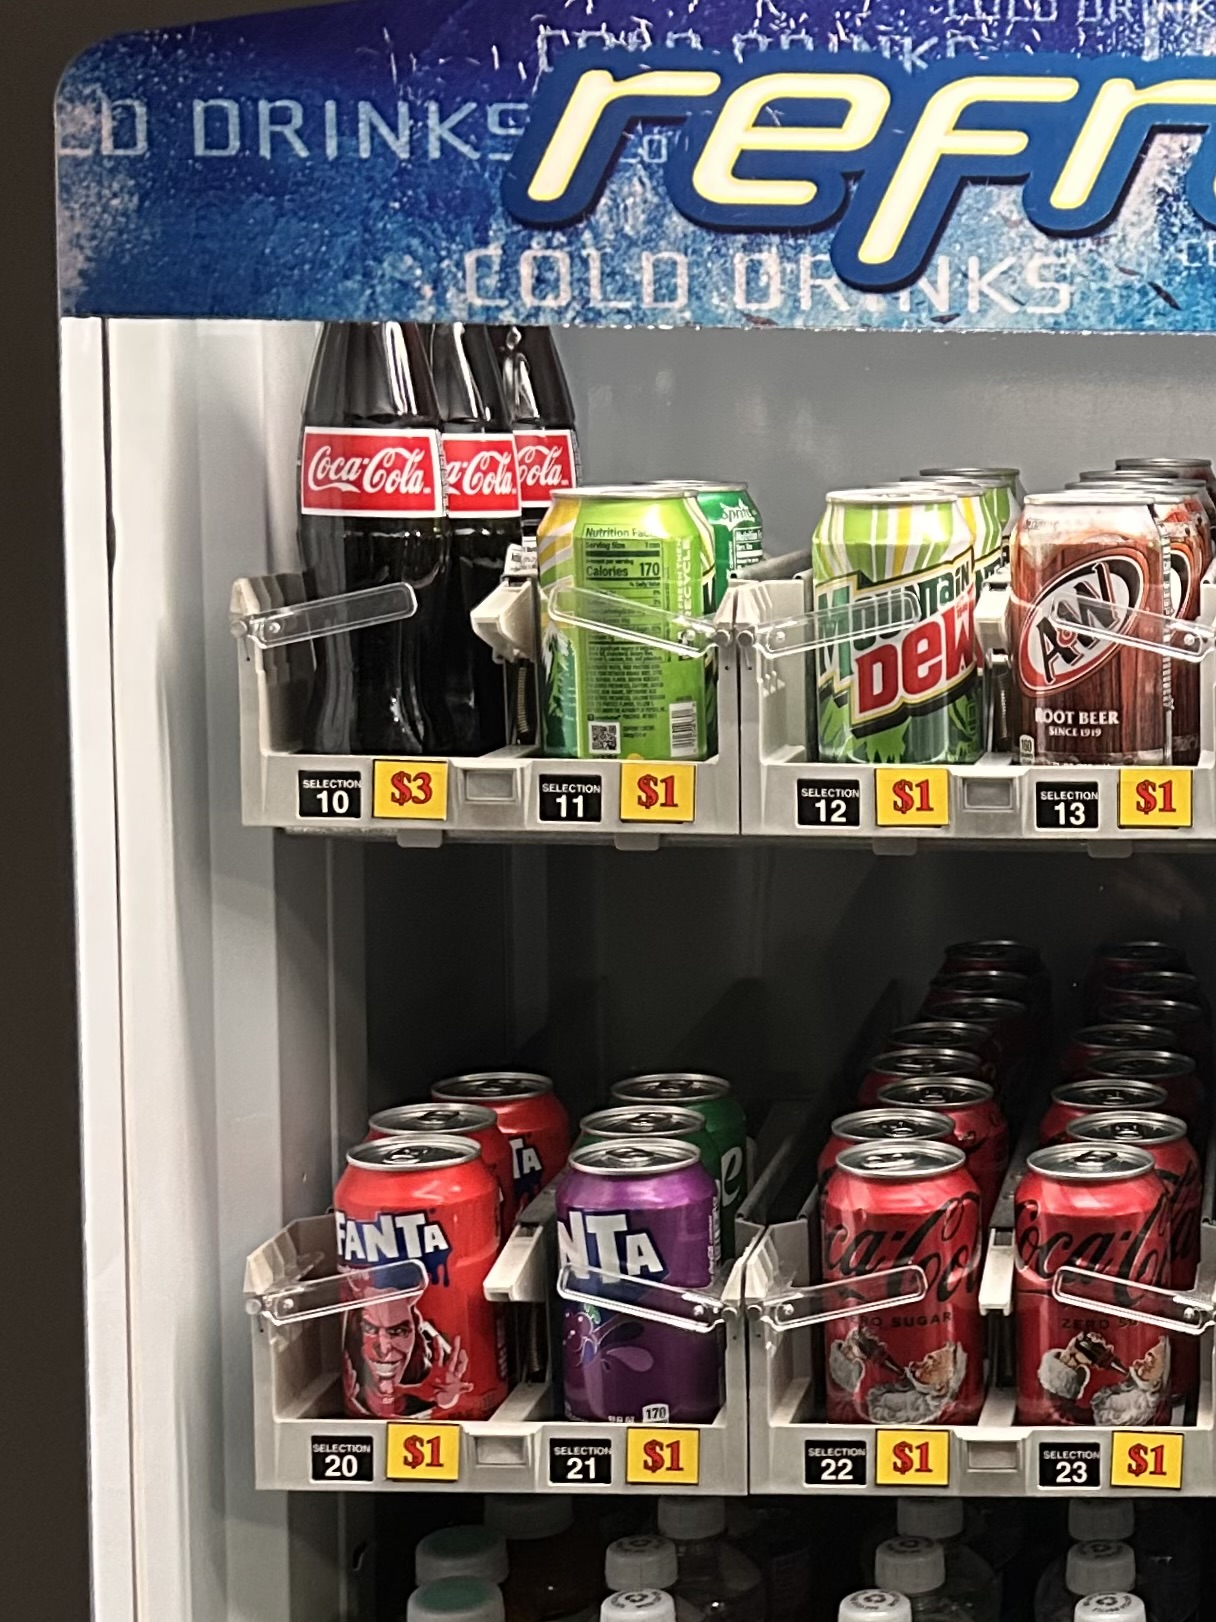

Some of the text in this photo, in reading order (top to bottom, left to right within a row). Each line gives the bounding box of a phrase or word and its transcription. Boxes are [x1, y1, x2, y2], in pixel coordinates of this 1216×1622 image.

[193, 98, 531, 161] DRINKS
[464, 246, 689, 310] COLD
[307, 444, 426, 495] Coca-Cola
[585, 527, 630, 538] Nutrition
[585, 565, 629, 578] Calories
[638, 561, 661, 577] 170
[1035, 561, 1120, 685] A&W
[1034, 709, 1121, 726] ROOT BEER
[1049, 726, 1102, 738] SINCE 1919
[302, 778, 360, 788] SELECTION
[391, 771, 432, 806] $3
[541, 783, 601, 793] SELECTION
[636, 774, 678, 810] $1
[800, 787, 859, 797] SELECTION
[1039, 790, 1098, 800] SELECTION
[316, 790, 349, 814] 10
[555, 794, 584, 818] 11
[891, 779, 934, 815] $1
[1134, 780, 1176, 816] $1
[814, 799, 847, 823] 12
[1054, 801, 1086, 826] 13
[336, 1210, 449, 1263] FANTA
[890, 1311, 953, 1328] SUGAR
[1060, 1317, 1111, 1331] ZERO
[644, 1405, 667, 1421] 170
[312, 1443, 372, 1453] SELECTION
[402, 1435, 445, 1470] $1
[642, 1439, 684, 1474] $1
[807, 1447, 866, 1456] SELECTION
[892, 1441, 933, 1475] $1
[1042, 1450, 1100, 1460] SELECTION
[324, 1454, 358, 1478] 20
[566, 1457, 596, 1480] 21
[820, 1458, 854, 1481] 22
[1055, 1461, 1088, 1484] 23
[1126, 1443, 1168, 1478] $1
